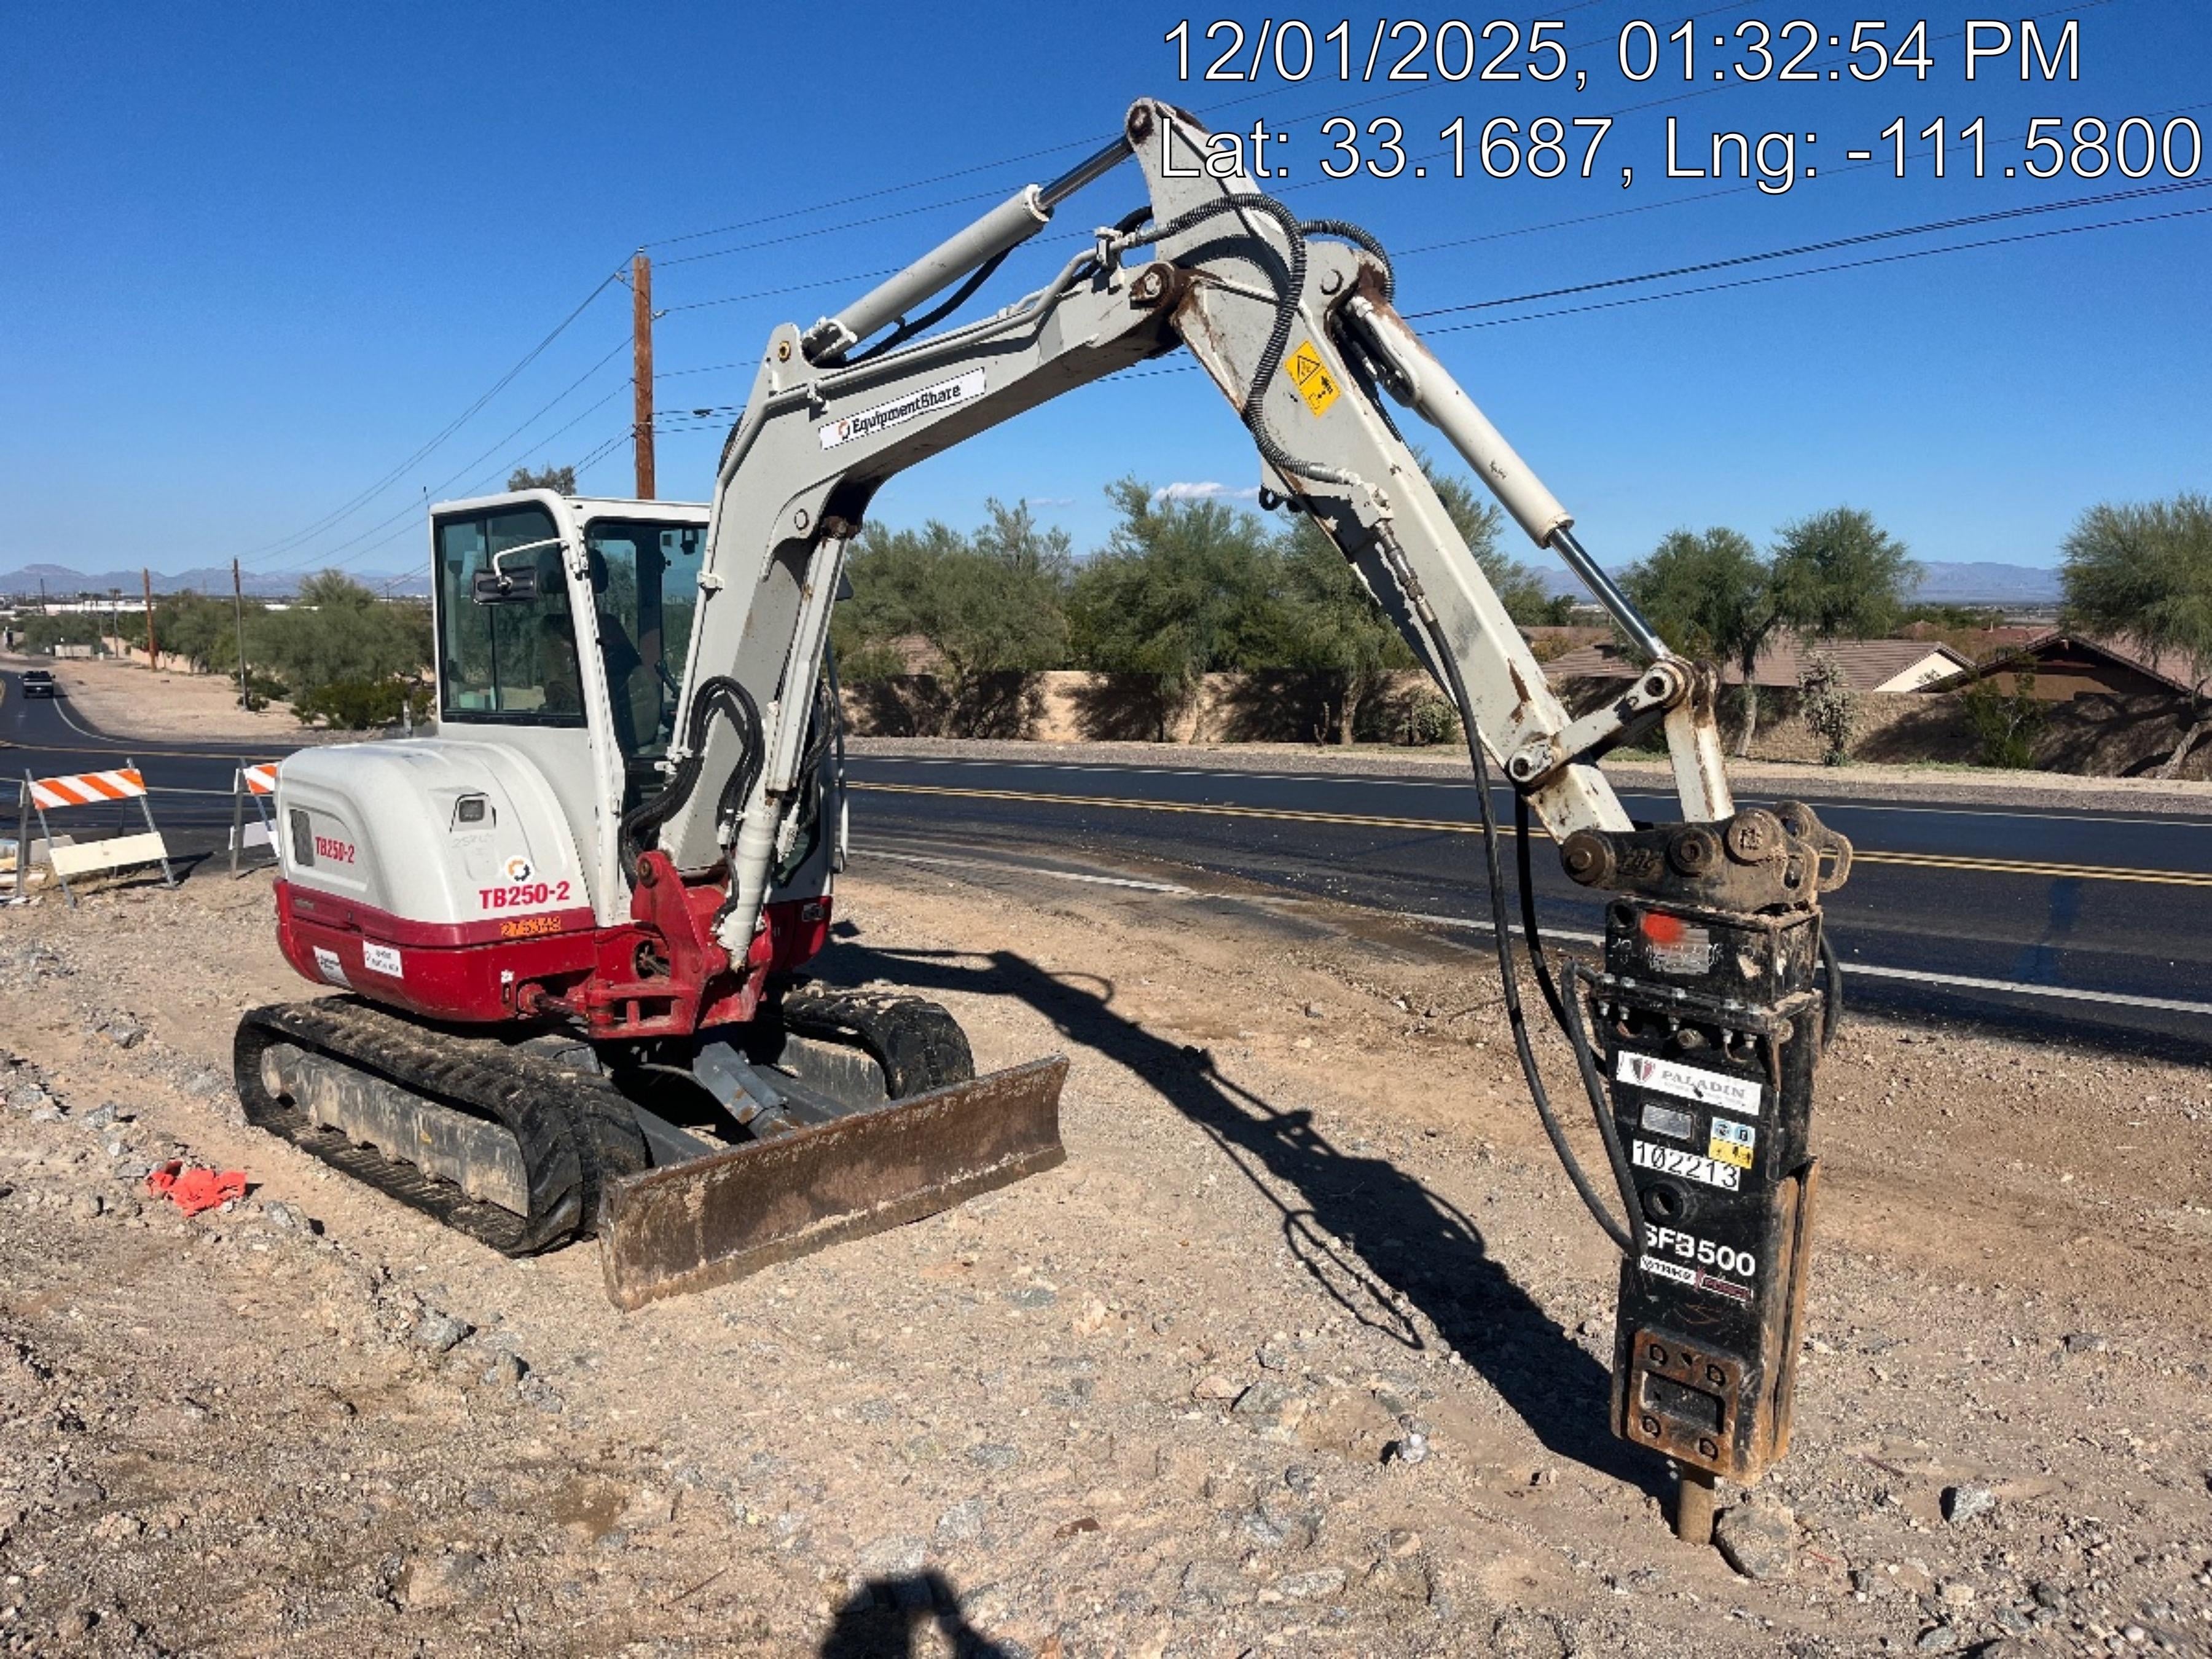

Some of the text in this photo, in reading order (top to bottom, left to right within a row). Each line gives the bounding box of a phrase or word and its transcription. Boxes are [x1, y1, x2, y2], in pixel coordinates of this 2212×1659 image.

[852, 385, 961, 434] EquipmentShare
[315, 836, 355, 864] TB250-2
[479, 880, 570, 909] TB250-2
[1661, 1070, 1746, 1099] PALADIN
[1636, 1142, 1738, 1188] 102213
